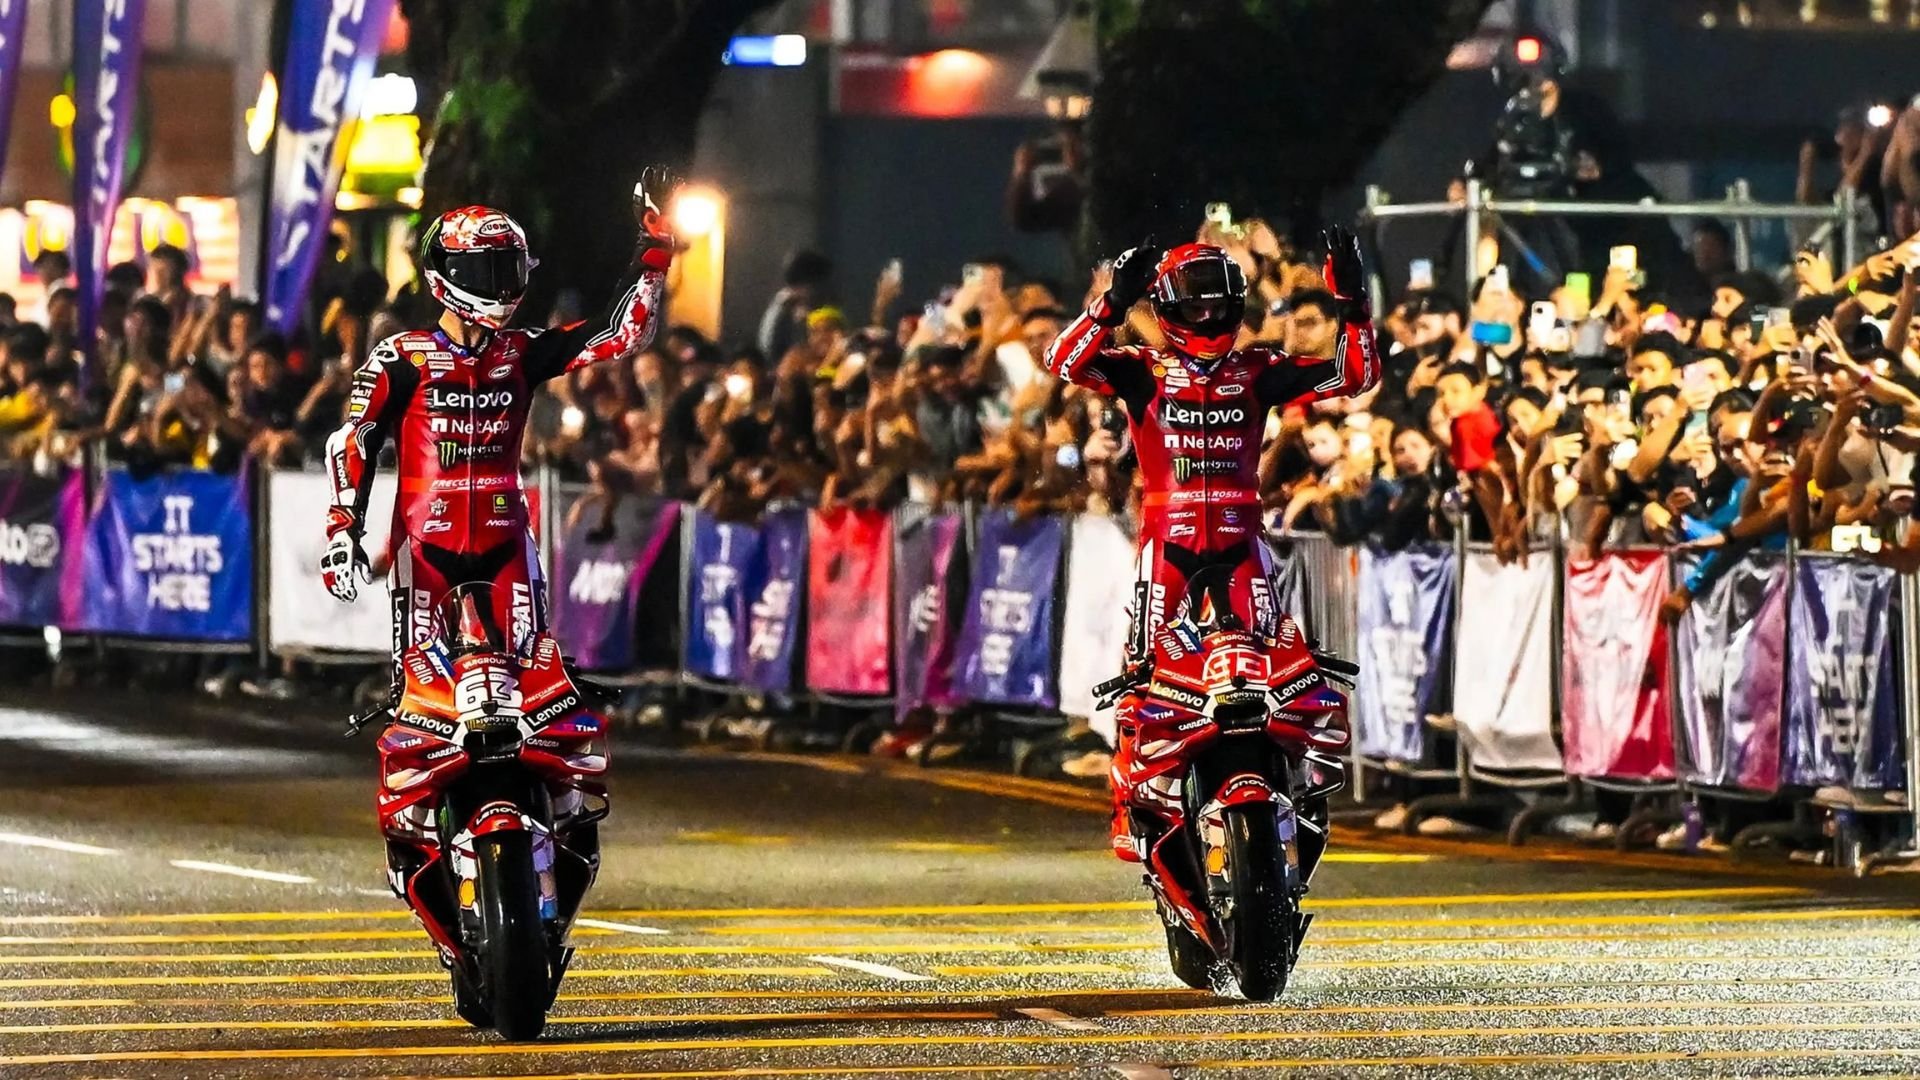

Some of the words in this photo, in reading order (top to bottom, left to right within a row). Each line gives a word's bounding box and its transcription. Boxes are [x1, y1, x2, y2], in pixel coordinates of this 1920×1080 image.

[433, 389, 513, 408] Lenovo
[1220, 385, 1241, 394] SHOEI
[1165, 404, 1244, 425] Lenovo
[451, 419, 510, 435] NetApp
[458, 445, 503, 455] MONSTER
[1183, 435, 1242, 451] NetApp
[1191, 460, 1238, 470] MONSTER
[163, 495, 193, 533] IT
[132, 534, 223, 572] STARTS
[1157, 635, 1184, 660] riello
[407, 657, 434, 685] riello
[455, 670, 523, 713] 63
[1152, 682, 1204, 707] Lenovo
[1273, 672, 1319, 702] Lenovo
[400, 708, 454, 735] Lenovo
[527, 696, 577, 727] Lenovo
[1153, 710, 1175, 720] TIM
[575, 724, 598, 733] TIM
[400, 738, 422, 749] TIM
